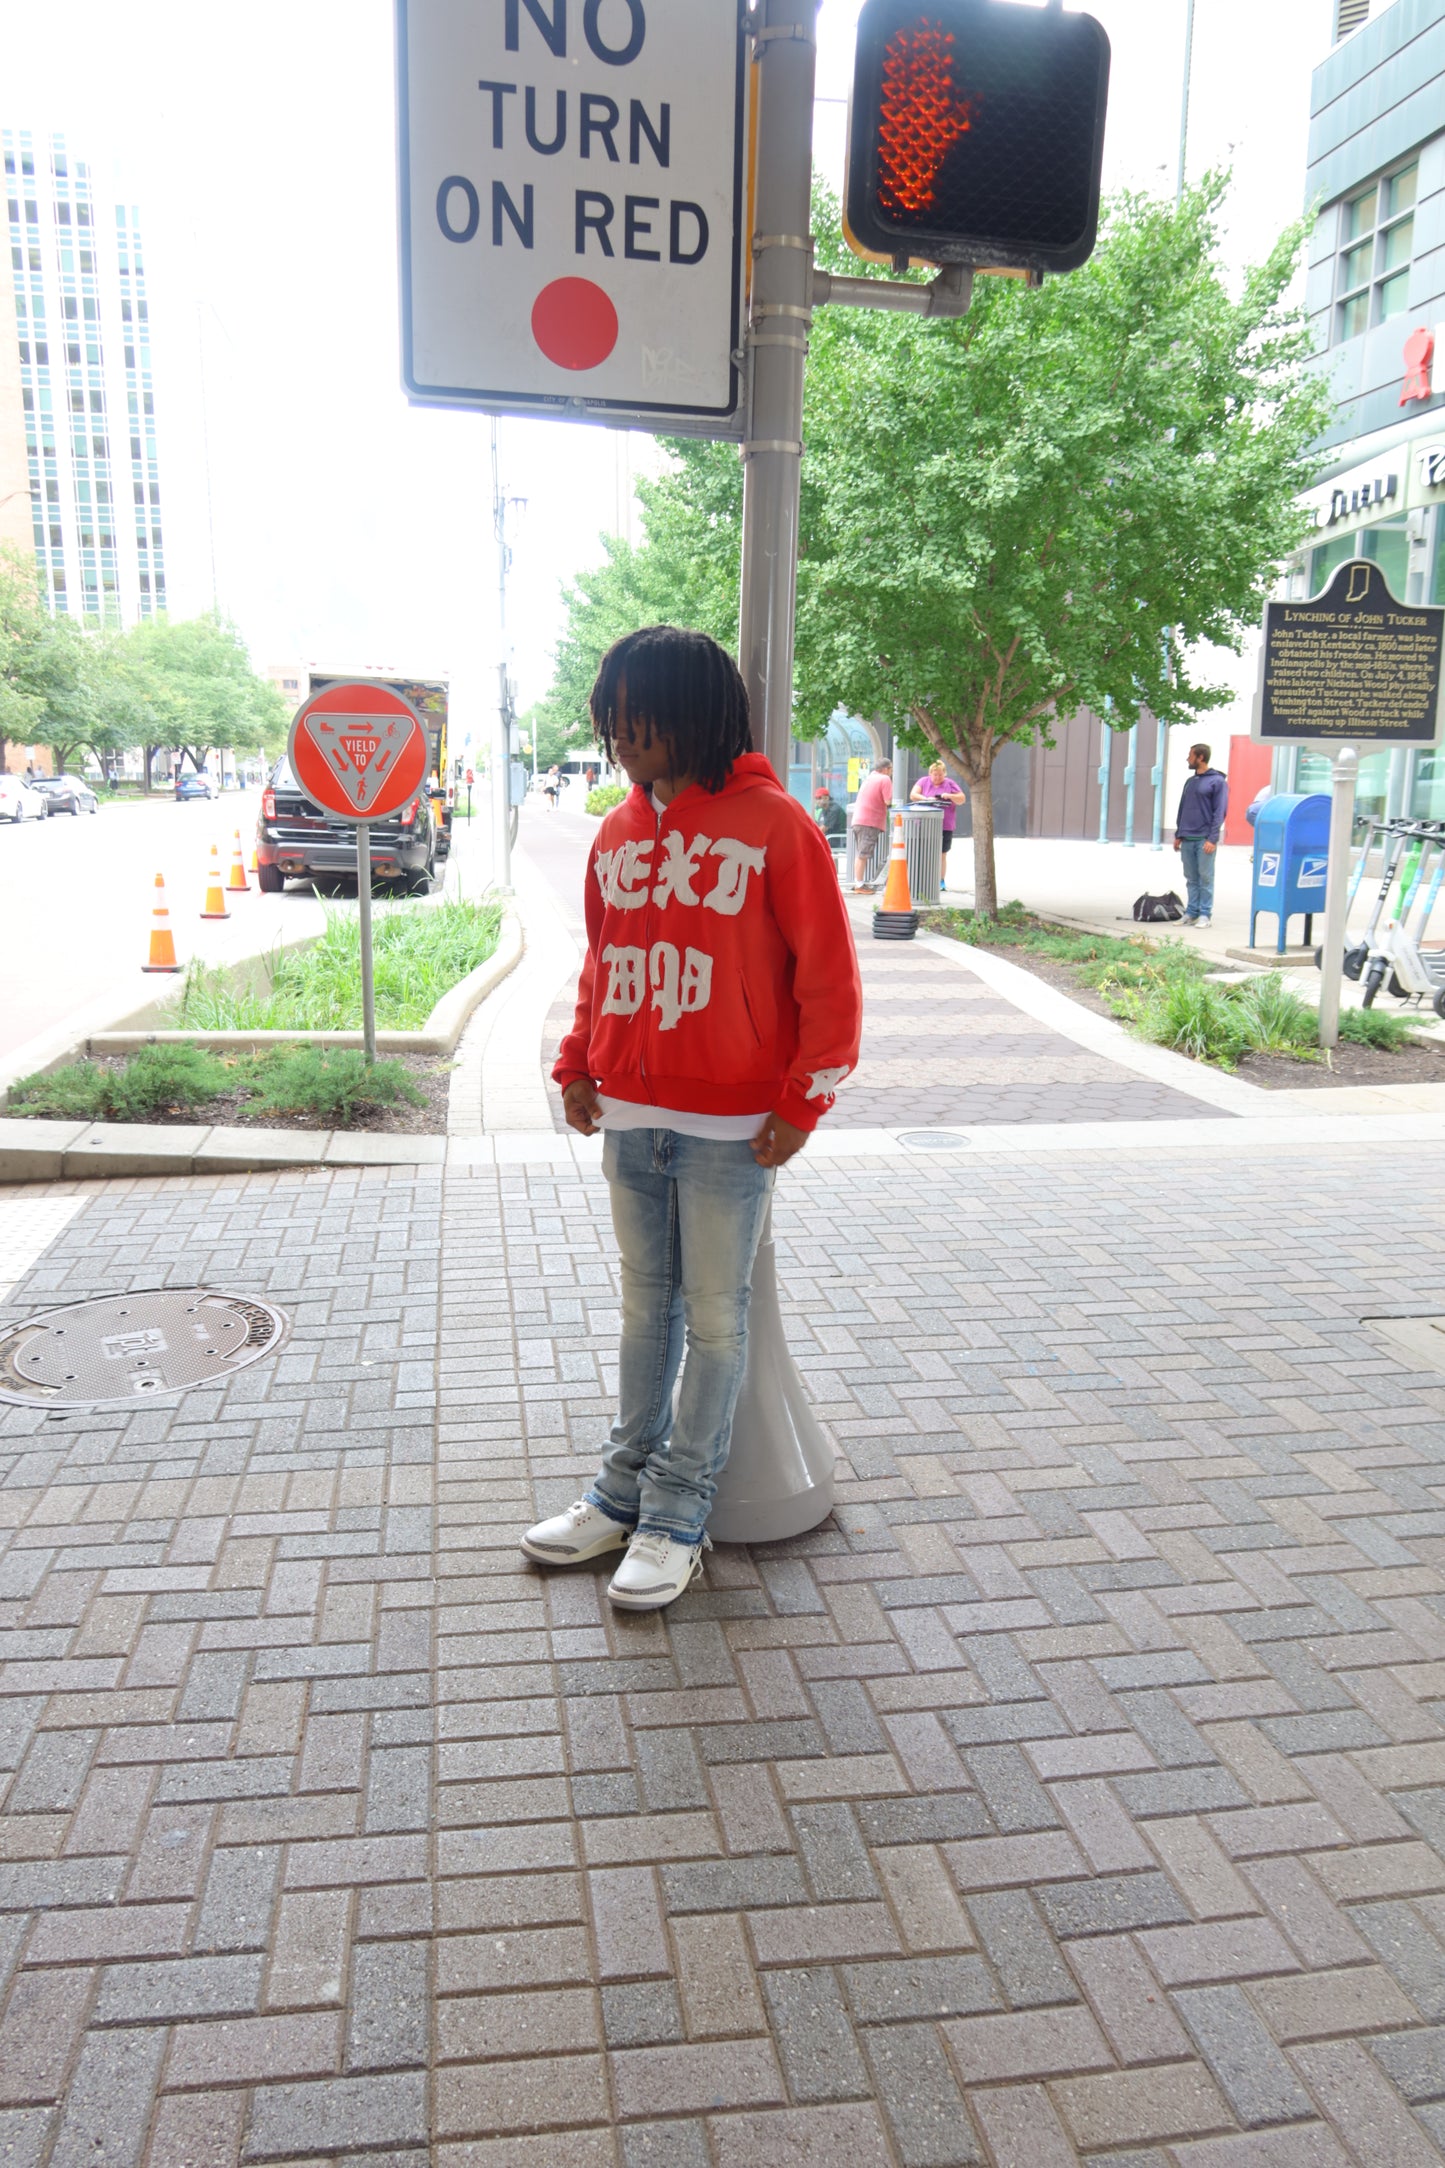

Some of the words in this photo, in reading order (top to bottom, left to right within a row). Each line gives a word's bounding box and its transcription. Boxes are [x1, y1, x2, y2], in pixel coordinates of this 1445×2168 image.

[504, 0, 646, 66] NO
[478, 80, 671, 168] TURN
[436, 175, 534, 249] ON
[575, 189, 709, 265] RED
[1284, 609, 1336, 622] LYNCHING
[1338, 613, 1352, 623] OF
[1354, 611, 1384, 624] JOHN
[1387, 613, 1428, 626] TUCKER
[1272, 628, 1294, 638] John
[1295, 629, 1331, 639] Tucker,
[1339, 631, 1362, 640] local
[1363, 631, 1397, 641] farmer,
[1415, 633, 1437, 642] born
[1271, 639, 1309, 648] enslaved
[1310, 640, 1319, 648] in
[1321, 639, 1362, 650] Kentucky
[1397, 642, 1414, 651] and
[1415, 643, 1437, 652] later
[1279, 649, 1318, 657] obtained
[1320, 649, 1332, 658] his
[1333, 650, 1373, 659] freedom.
[1375, 651, 1387, 660] He
[1388, 653, 1417, 661] moved
[1418, 653, 1428, 661] to
[1270, 658, 1325, 669] Indianapolis
[1326, 659, 1338, 669] by
[1340, 660, 1354, 669] the
[1399, 662, 1423, 671] where
[1423, 663, 1435, 671] he
[1273, 669, 1301, 677] raised
[1302, 669, 1319, 677] two
[1320, 669, 1359, 679] children.
[1360, 670, 1374, 679] On
[1375, 671, 1396, 681] July
[1266, 677, 1291, 686] white
[1292, 677, 1325, 687] laborer
[1327, 678, 1362, 688] Nicholas
[1364, 680, 1388, 688] Wood
[1389, 681, 1436, 692] physically
[1273, 687, 1316, 696] assaulted
[1317, 687, 1349, 697] Tucker
[1360, 689, 1370, 698] he
[1372, 690, 1401, 698] walked
[1403, 691, 1427, 701] along
[1270, 696, 1322, 707] Washington
[1324, 698, 1355, 707] Street.
[1356, 698, 1387, 708] Tucker
[1388, 699, 1429, 709] defended
[1273, 706, 1307, 715] himself
[1307, 707, 1340, 717] against
[1371, 709, 1399, 718] attack
[1401, 709, 1425, 718] while
[1287, 717, 1334, 727] retreating
[1335, 719, 1347, 728] up
[1348, 717, 1377, 727] Illinois
[1379, 718, 1410, 728] Street.
[345, 740, 375, 752] YIELD
[354, 753, 367, 766] TO
[593, 829, 768, 916] NEXT
[227, 1300, 273, 1348] ELECTRIC
